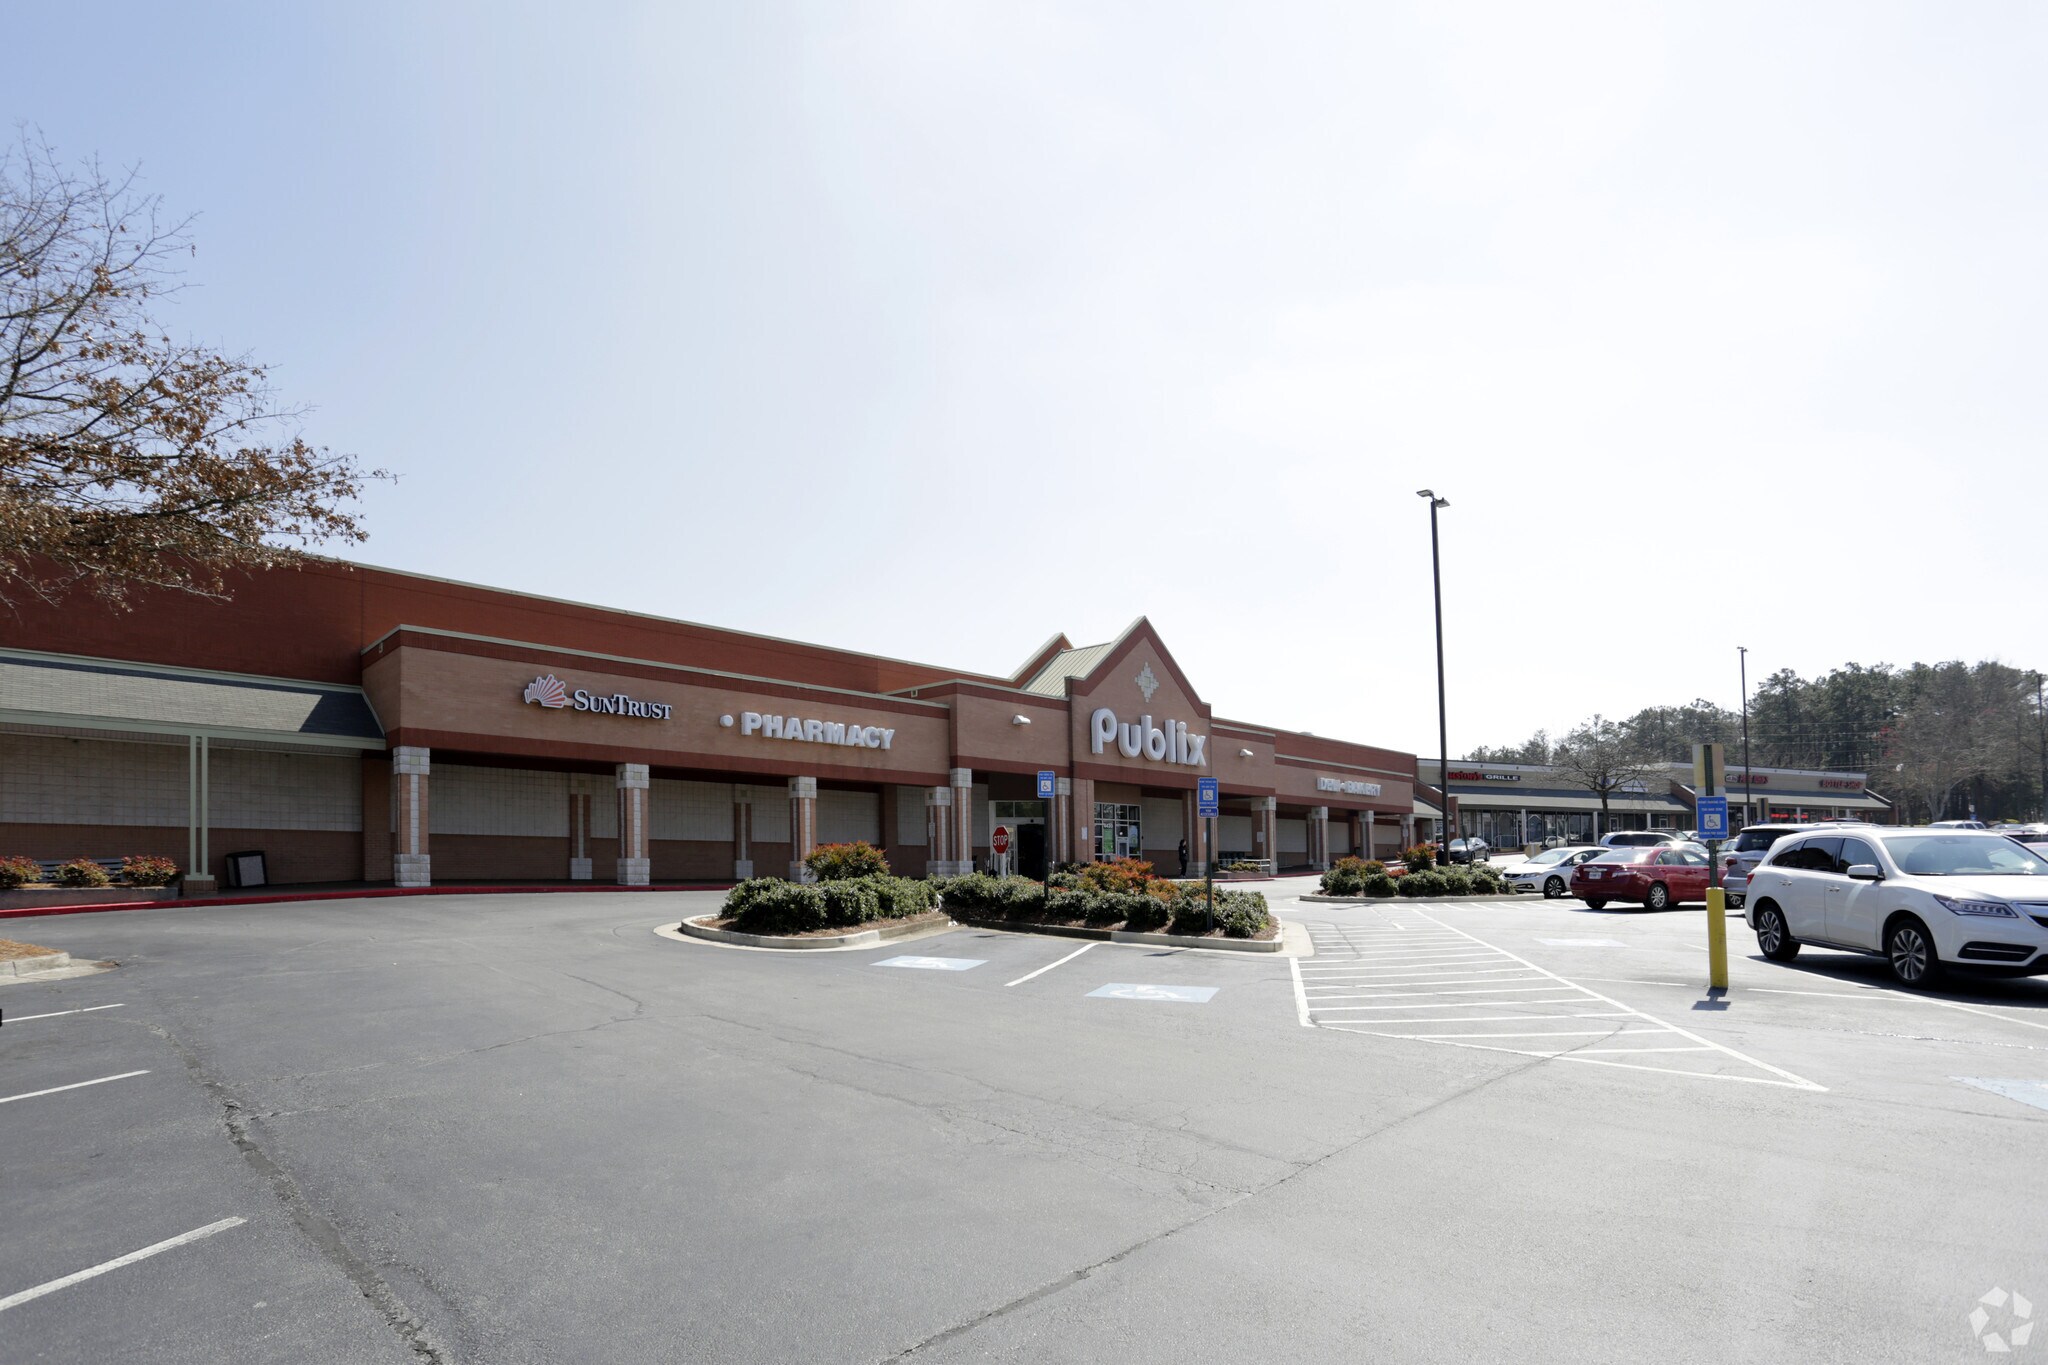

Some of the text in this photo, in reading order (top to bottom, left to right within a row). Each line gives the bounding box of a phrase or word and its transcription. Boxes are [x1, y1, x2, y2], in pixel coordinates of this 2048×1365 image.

[741, 711, 895, 750] PHARMACY
[1091, 708, 1206, 767] Publix
[1485, 773, 1519, 781] GRILLE
[993, 835, 1007, 846] STOP
